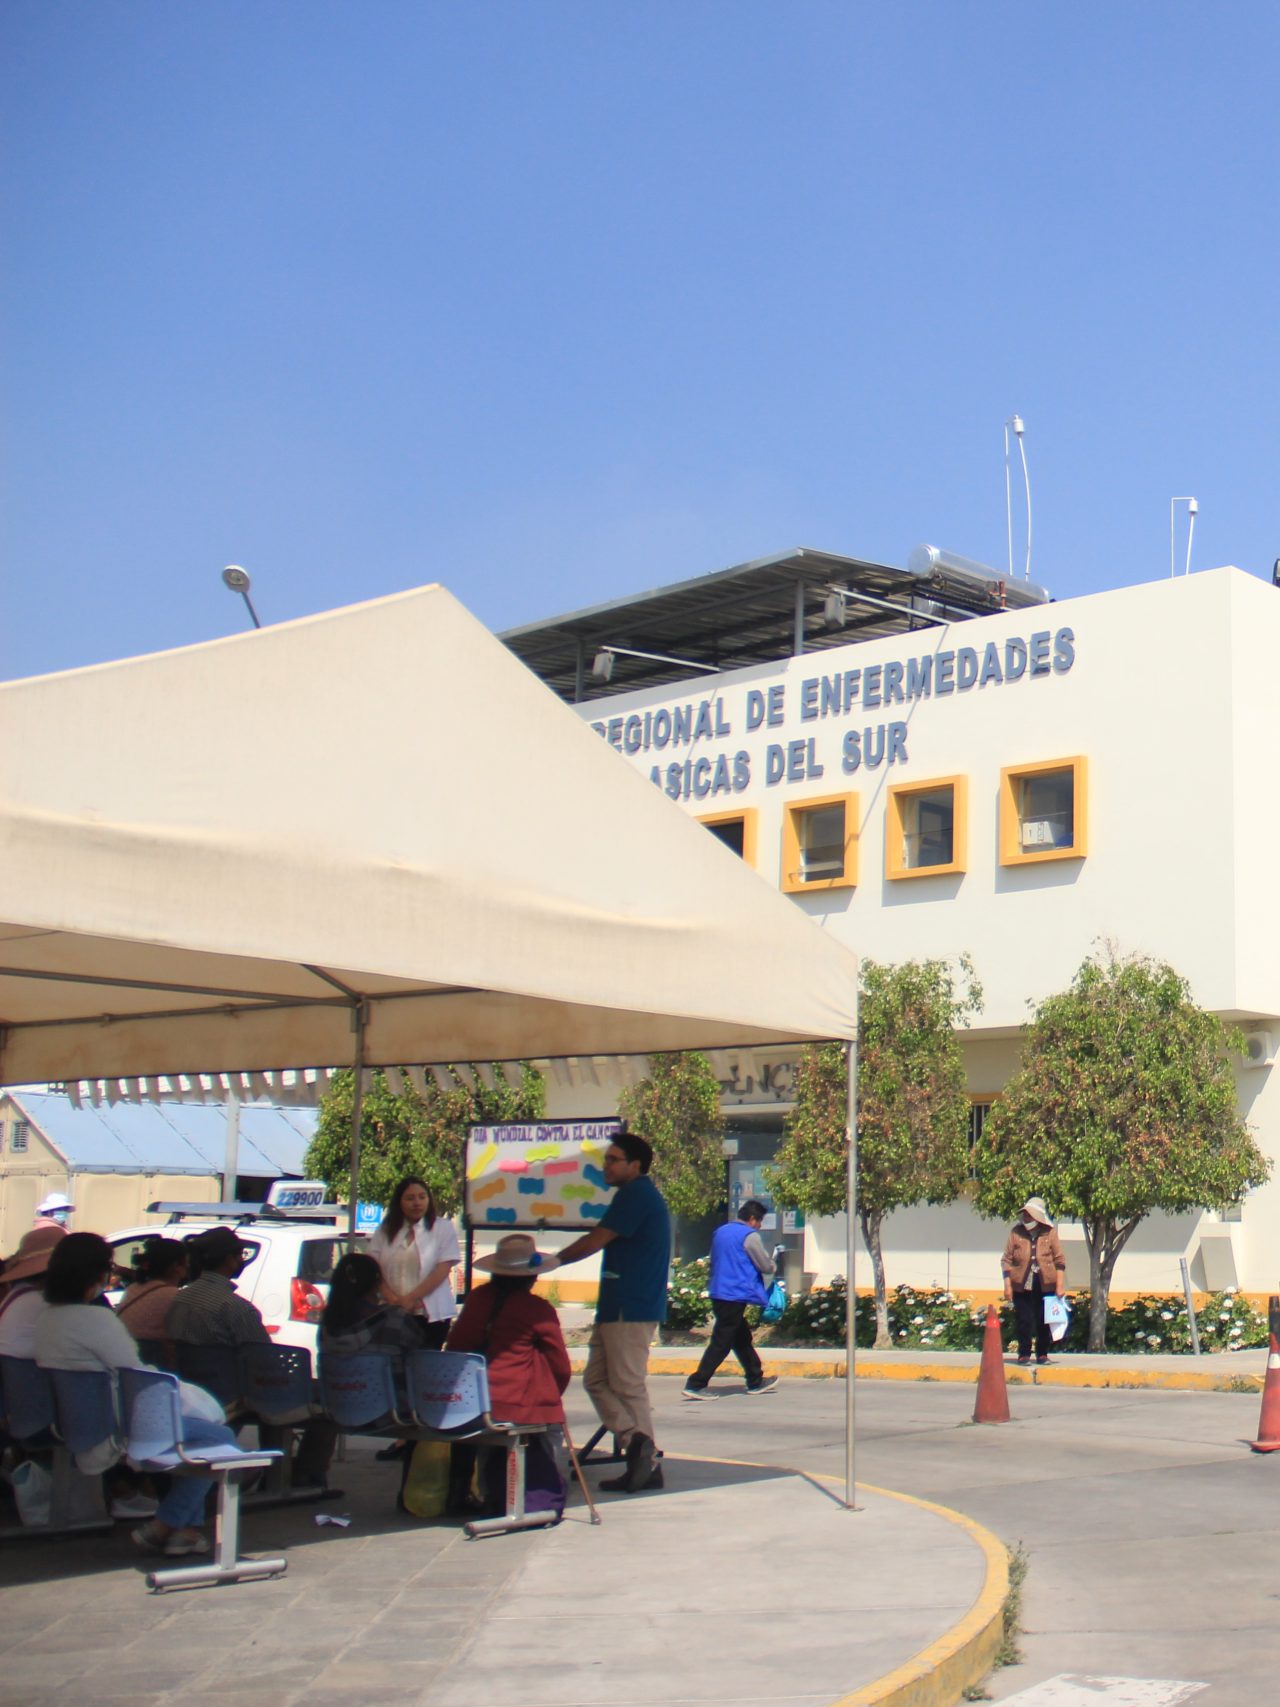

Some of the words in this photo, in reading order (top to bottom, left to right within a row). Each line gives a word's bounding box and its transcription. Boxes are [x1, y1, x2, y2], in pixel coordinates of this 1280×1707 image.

[746, 685, 785, 729] DE
[801, 627, 1075, 720] ENFERMEDADES
[766, 737, 823, 784] DEL
[842, 721, 908, 772] SUR
[572, 1124, 585, 1141] EL
[275, 1191, 323, 1207] 229900
